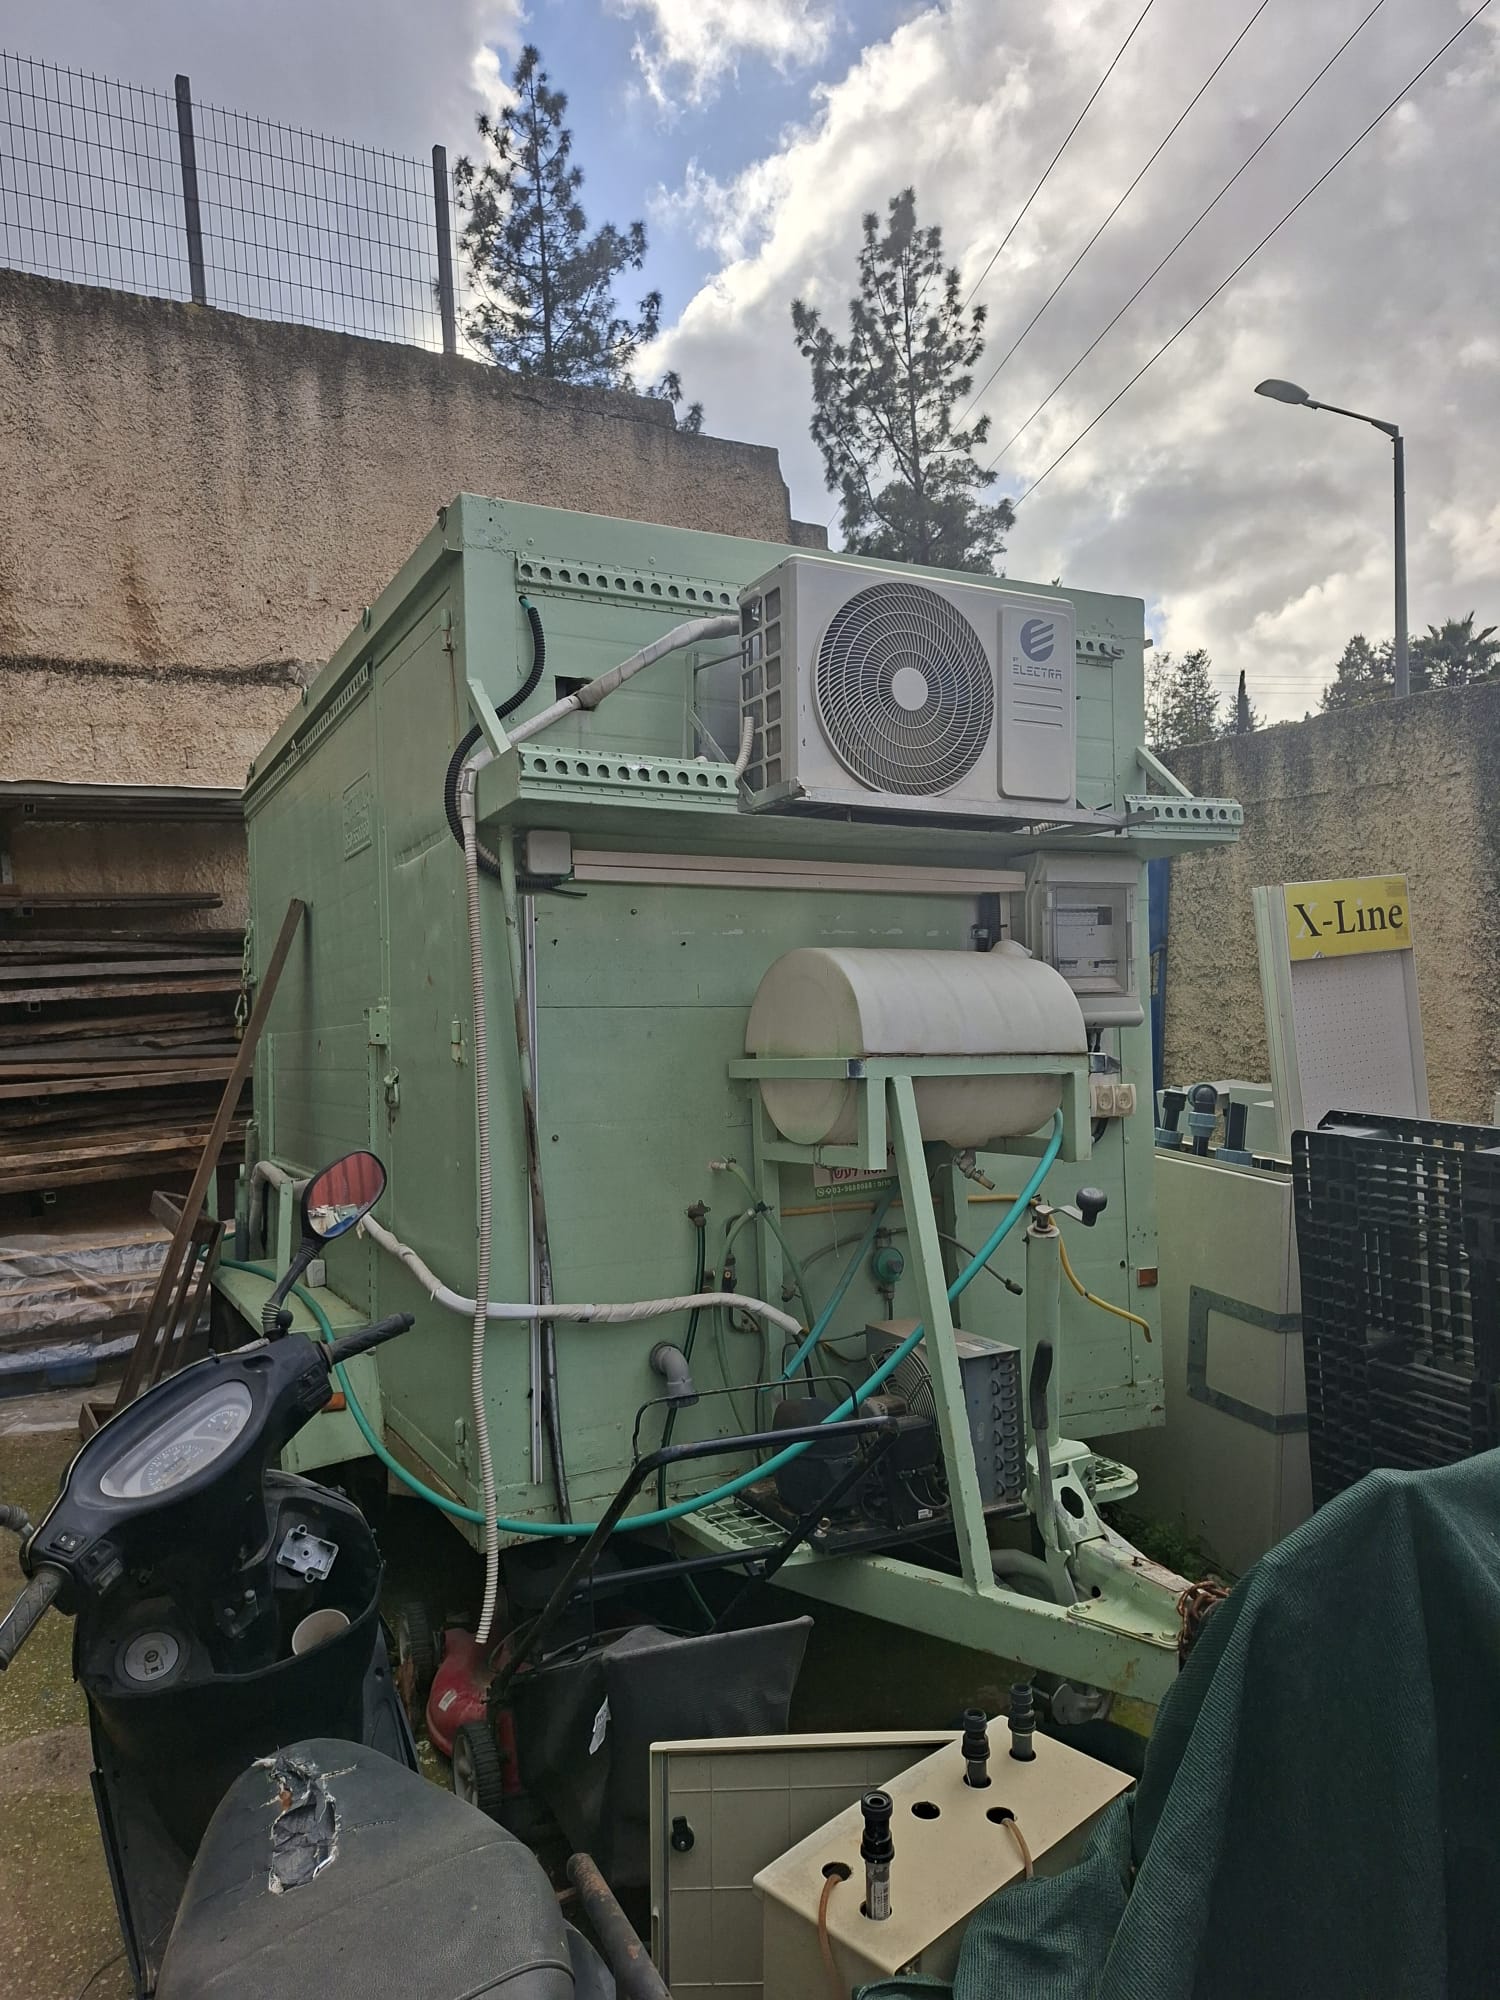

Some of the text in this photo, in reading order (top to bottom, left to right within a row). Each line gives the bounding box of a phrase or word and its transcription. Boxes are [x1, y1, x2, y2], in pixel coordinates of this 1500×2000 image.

[1013, 664, 1062, 680] ELECTRA
[1293, 898, 1404, 939] X-Line
[834, 1167, 858, 1179] לעש
